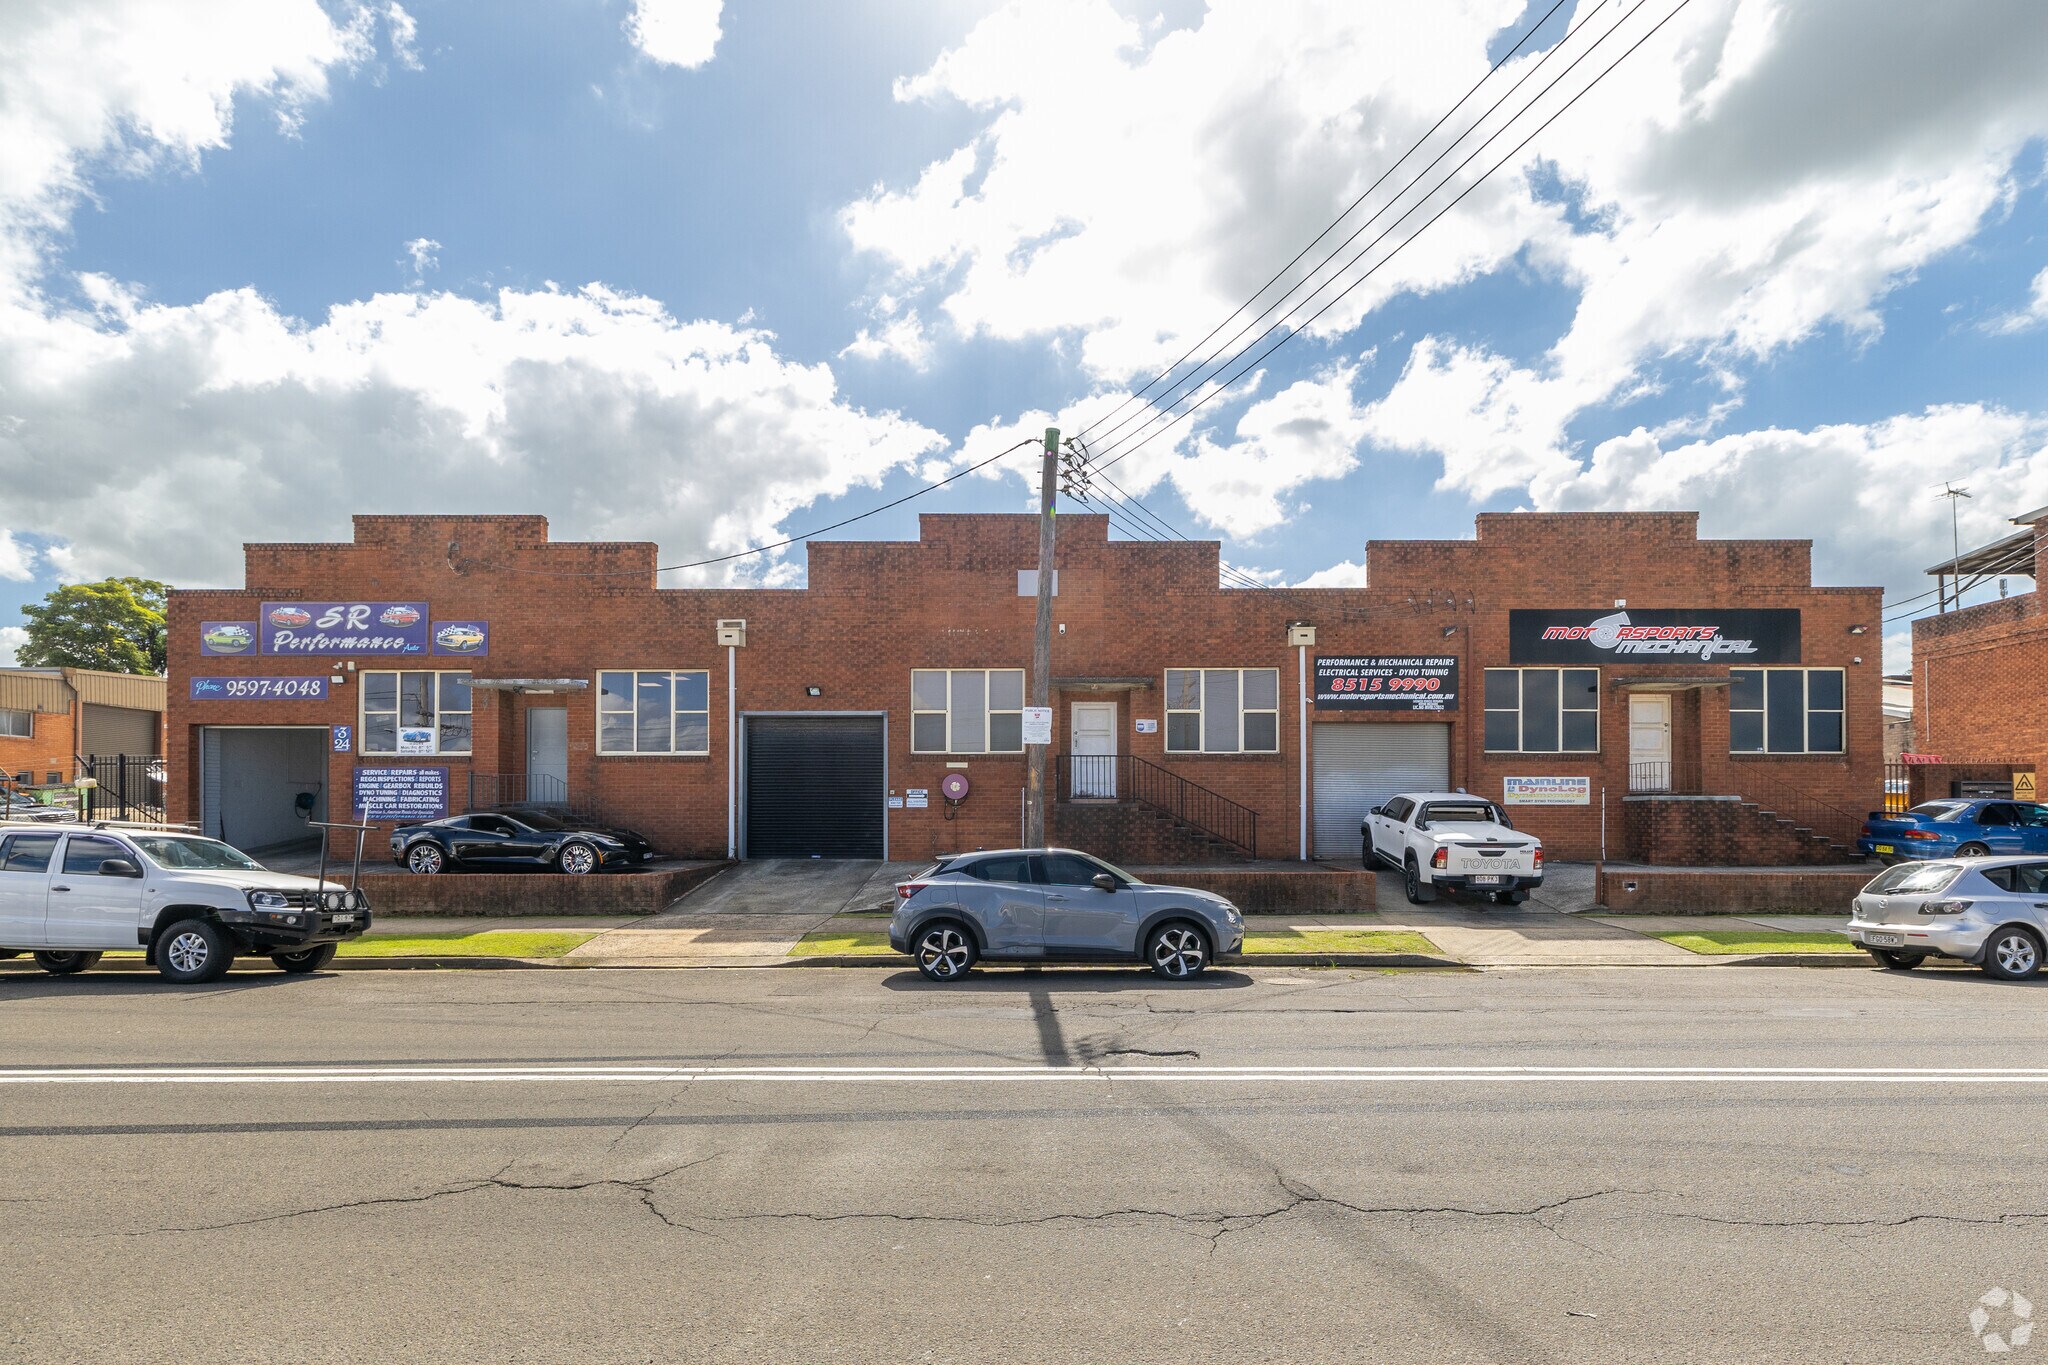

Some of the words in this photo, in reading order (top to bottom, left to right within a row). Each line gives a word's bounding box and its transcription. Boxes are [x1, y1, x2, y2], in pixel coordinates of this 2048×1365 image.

[315, 604, 371, 630] SR
[273, 630, 405, 652] Performance
[402, 643, 420, 653] Auto
[1317, 658, 1369, 666] PERFORMANCE
[1377, 658, 1423, 666] MECHANICAL
[1425, 658, 1454, 666] REPAIRS
[1318, 668, 1359, 676] ELECTRICAL
[1360, 668, 1393, 676] SERVICES
[1399, 668, 1419, 676] DYNO
[1421, 668, 1449, 676] TUNING
[195, 679, 222, 695] Phone
[1331, 677, 1382, 691] 8515
[1388, 677, 1440, 691] 9990
[1317, 693, 1454, 701] www.motorsportsmechanical.com.au
[338, 727, 347, 738] 3
[335, 738, 350, 750] 24
[1461, 858, 1520, 869] TOYOTA
